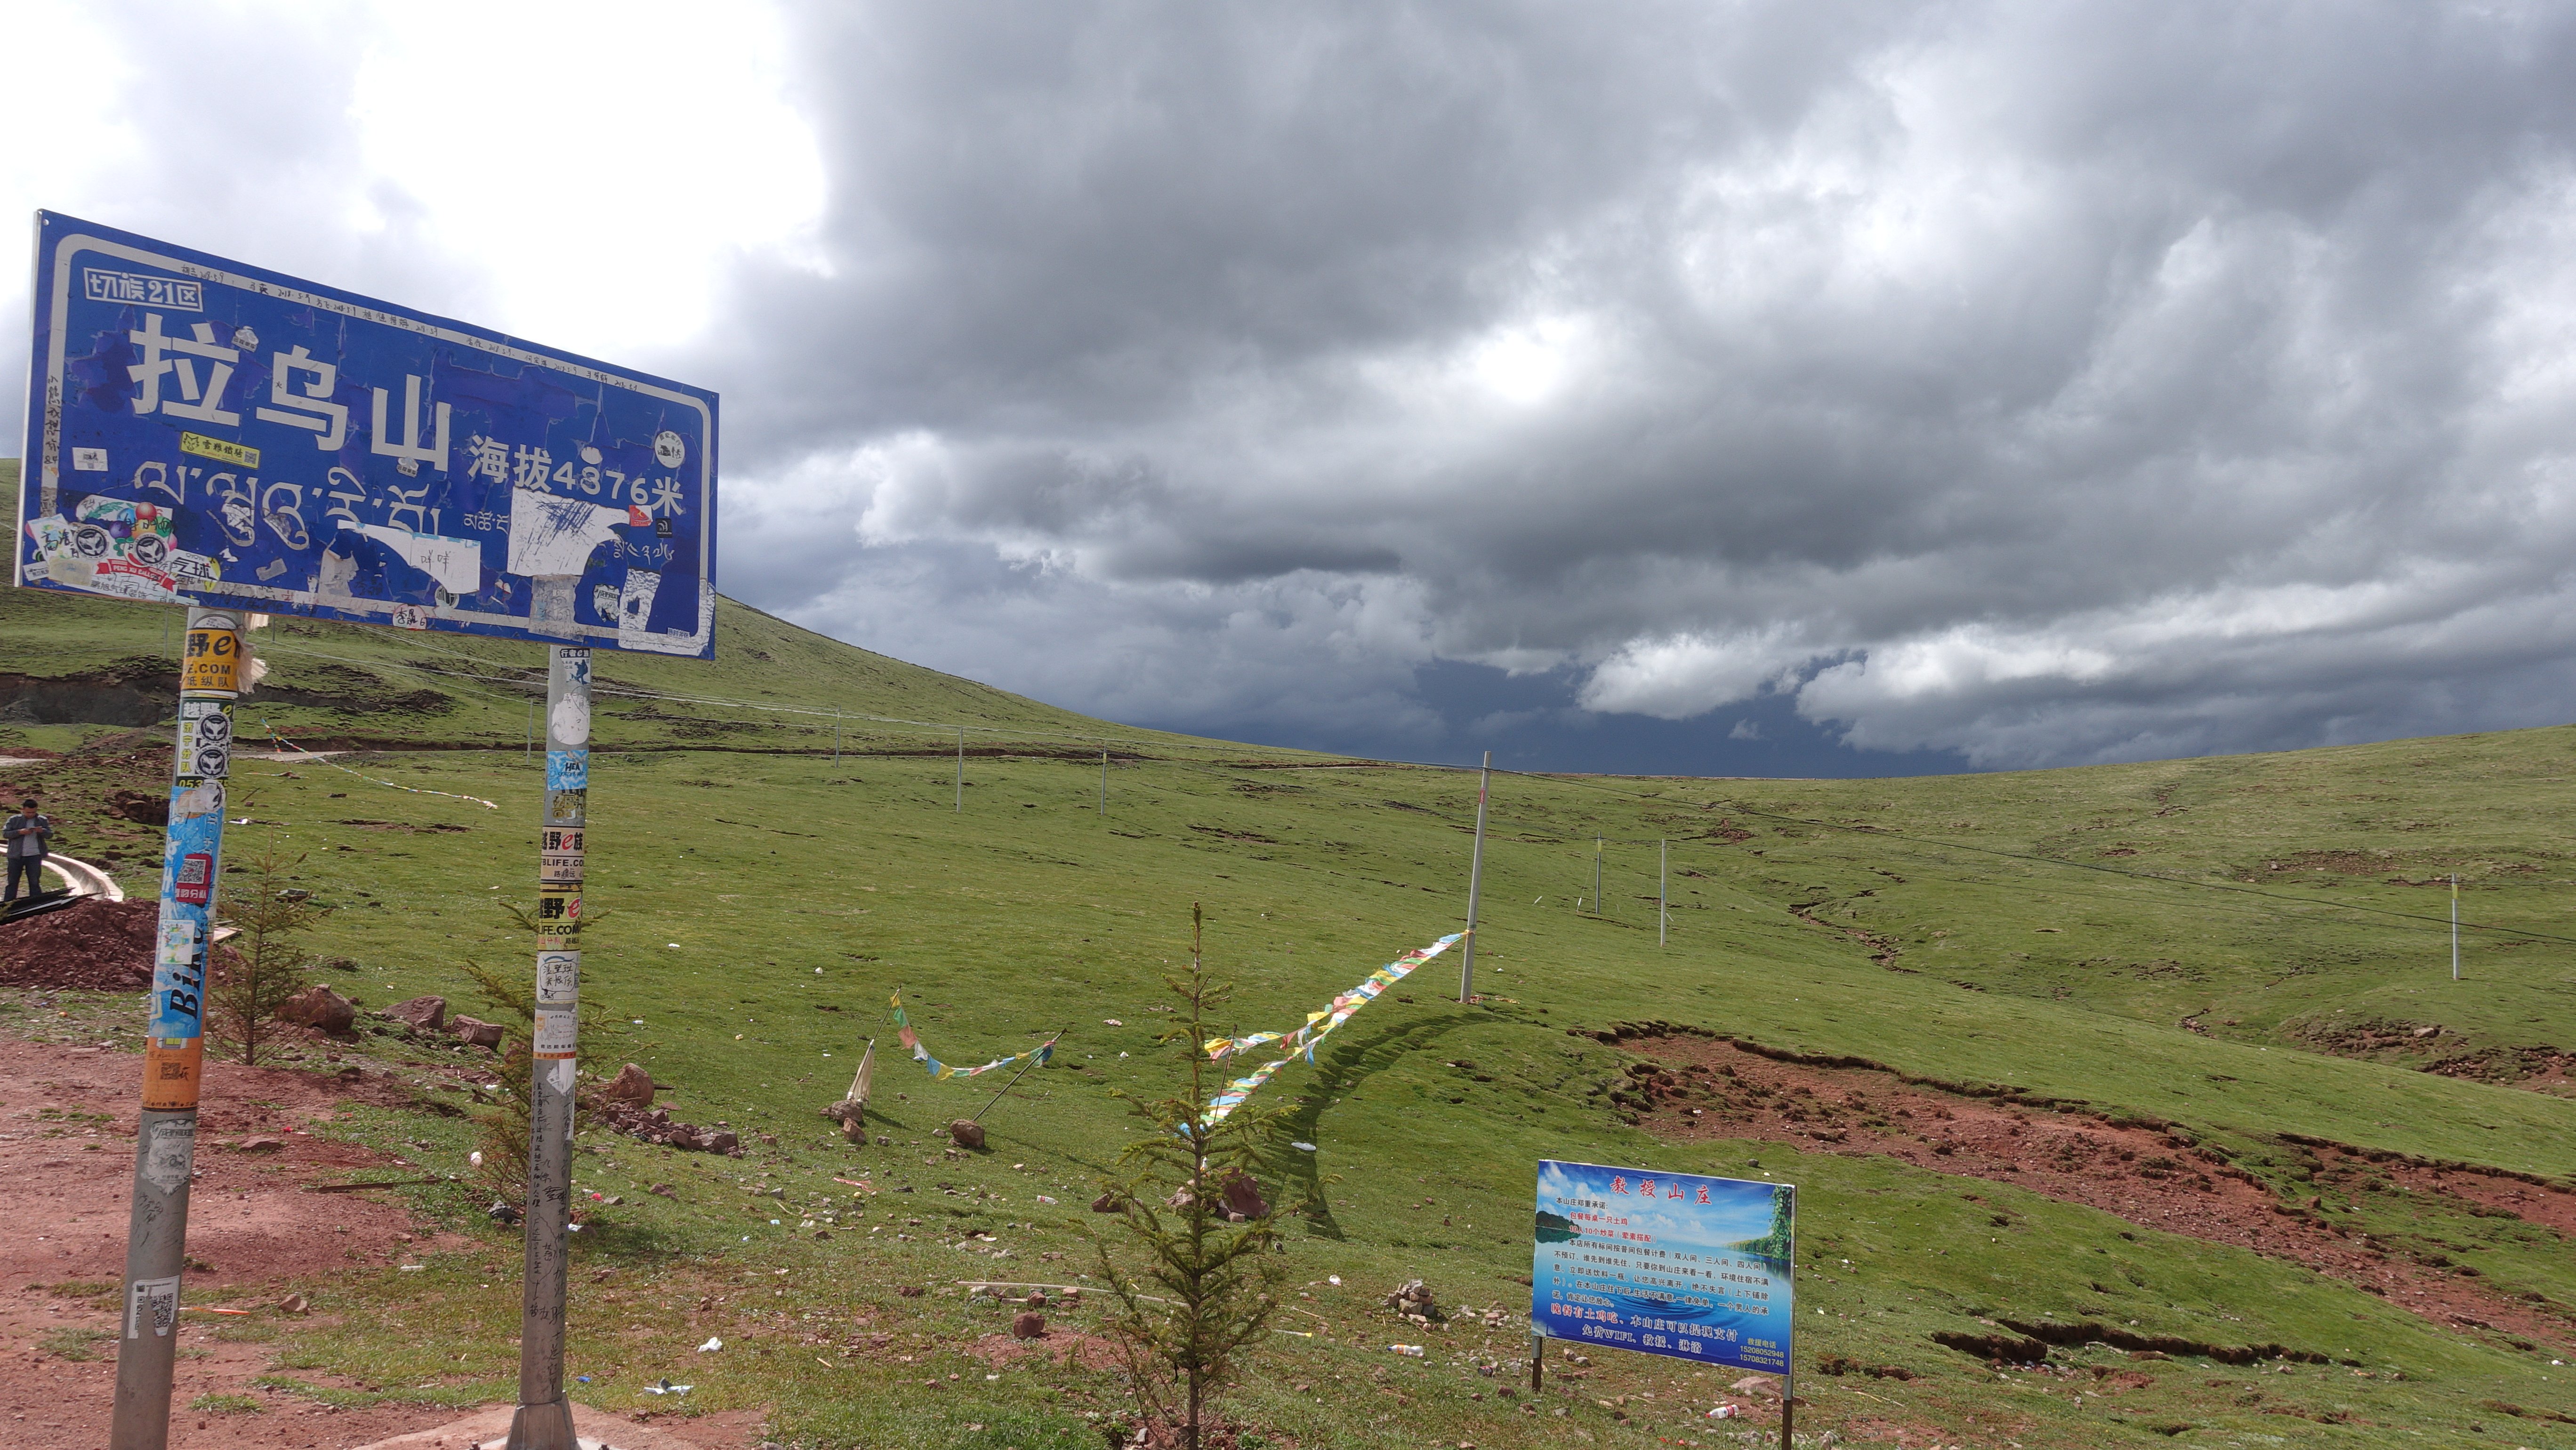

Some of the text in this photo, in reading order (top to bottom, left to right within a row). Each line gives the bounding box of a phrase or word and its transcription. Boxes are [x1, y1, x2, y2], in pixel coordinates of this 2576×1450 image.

[127, 313, 451, 472] 拉乌山
[1610, 1175, 1712, 1205] 教授山庄
[1570, 1212, 1628, 1225] 包餐每桌一只土鸡
[1747, 1337, 1777, 1349] 救援电话
